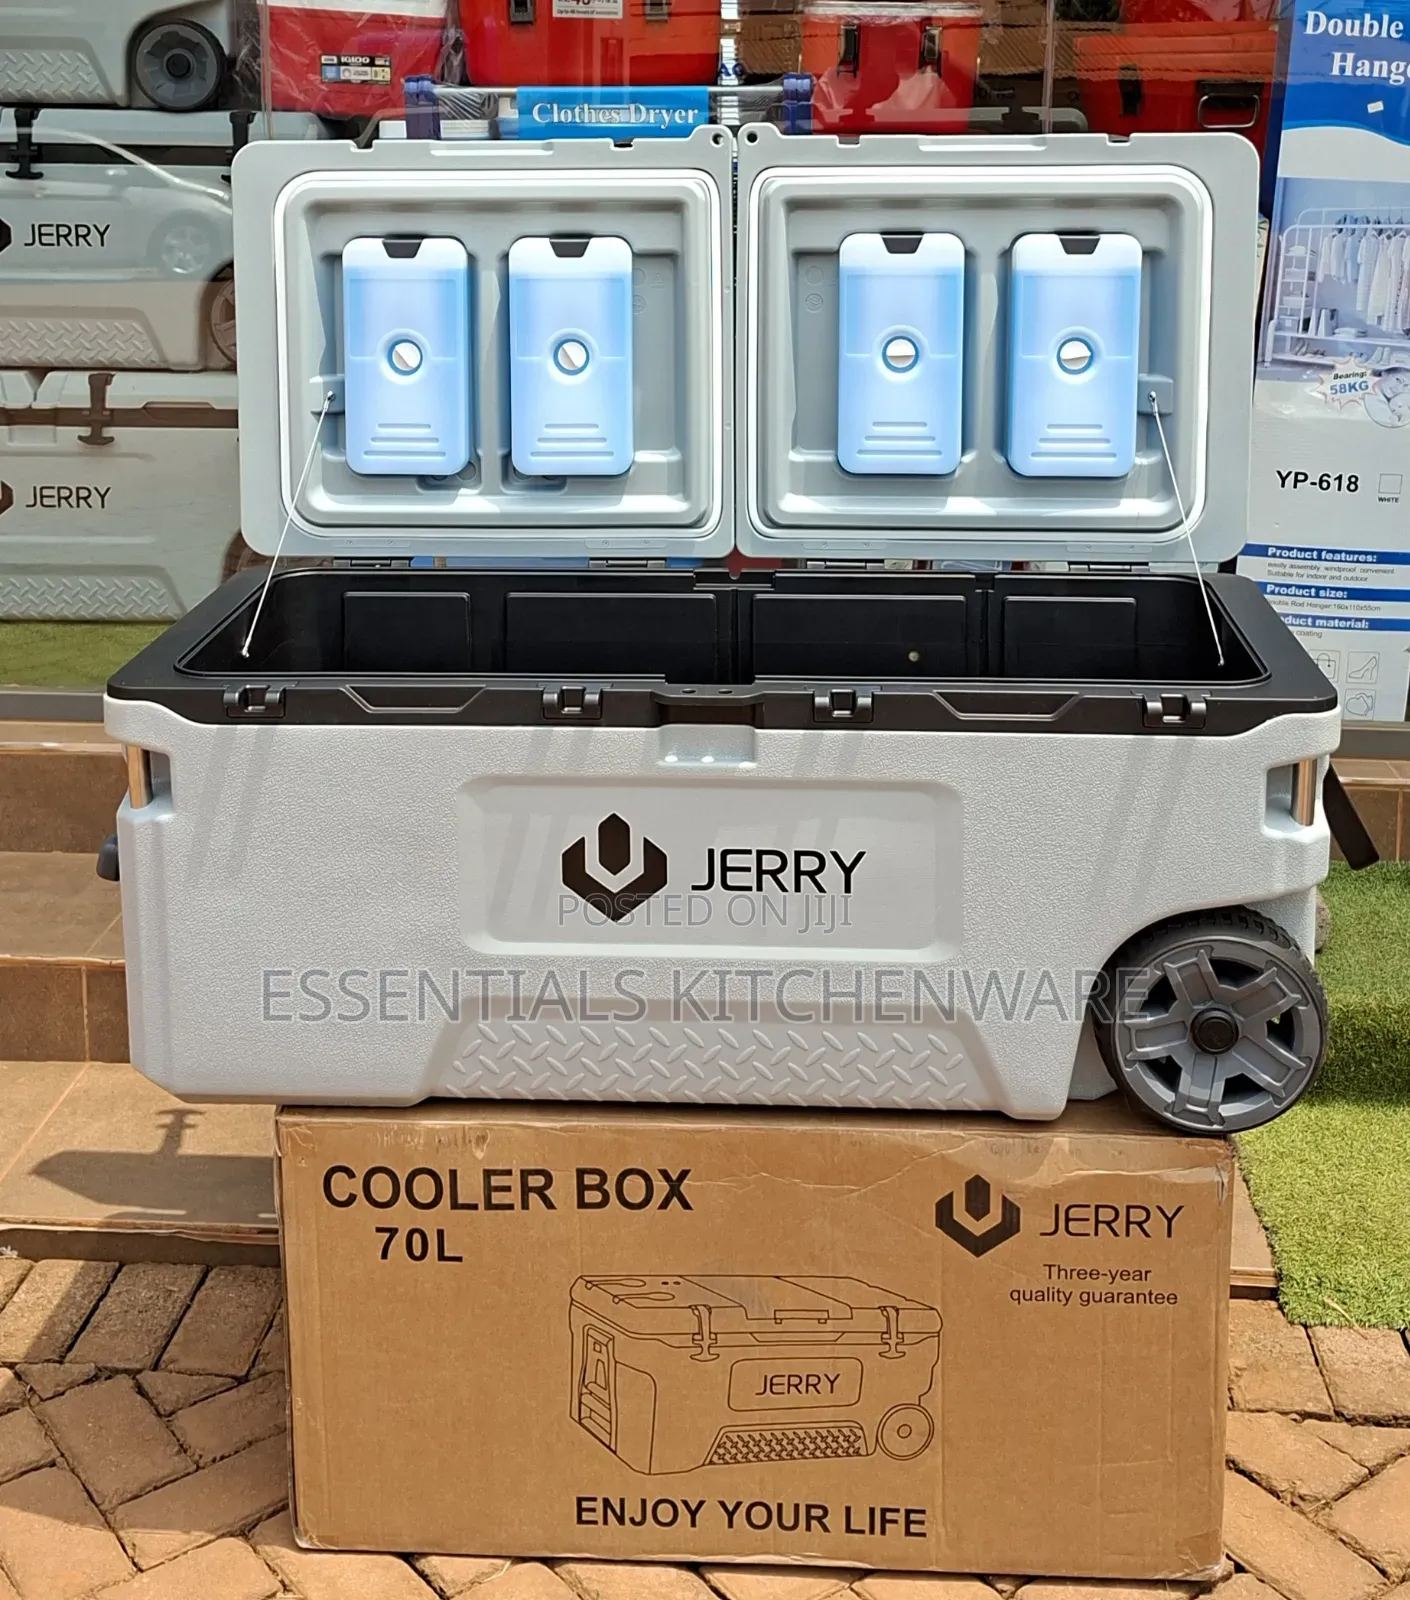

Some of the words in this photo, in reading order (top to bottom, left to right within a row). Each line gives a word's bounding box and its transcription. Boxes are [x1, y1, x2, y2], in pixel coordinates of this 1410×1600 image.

[1304, 10, 1404, 39] Double
[532, 102, 620, 124] Clothes
[628, 103, 699, 130] Dryer
[24, 223, 111, 248] JERRY
[1332, 370, 1368, 381] Bearing:
[1329, 380, 1370, 396] 58KG
[1275, 469, 1360, 493] YP-618
[25, 486, 112, 509] JERRY
[1377, 496, 1400, 504] WHITE
[1267, 547, 1318, 560] Product
[1321, 550, 1378, 563] features:
[1266, 570, 1294, 578] Suitable
[1295, 571, 1305, 579] for
[1306, 572, 1327, 580] indoor
[1328, 573, 1342, 581] and
[1343, 574, 1369, 582] outdoor
[1288, 563, 1321, 571] assembly
[1323, 565, 1357, 574] windproof
[1266, 583, 1316, 597] Product
[1318, 587, 1348, 599] size:
[1290, 600, 1305, 608] Rod
[1295, 629, 1323, 639] coating
[1315, 617, 1369, 629] material:
[690, 847, 867, 894] JERRY
[322, 1164, 558, 1211] COOLER
[575, 1166, 694, 1211] BOX
[1039, 1203, 1185, 1239] JERRY
[374, 1226, 463, 1263] 70L
[1043, 1264, 1152, 1285] Three-year
[1009, 1286, 1073, 1307] quality
[1078, 1288, 1178, 1308] guarantee
[754, 1373, 841, 1395] JERRY
[575, 1496, 707, 1529] ENJOY
[717, 1499, 831, 1534] YOUR
[844, 1505, 927, 1538] LIFE
